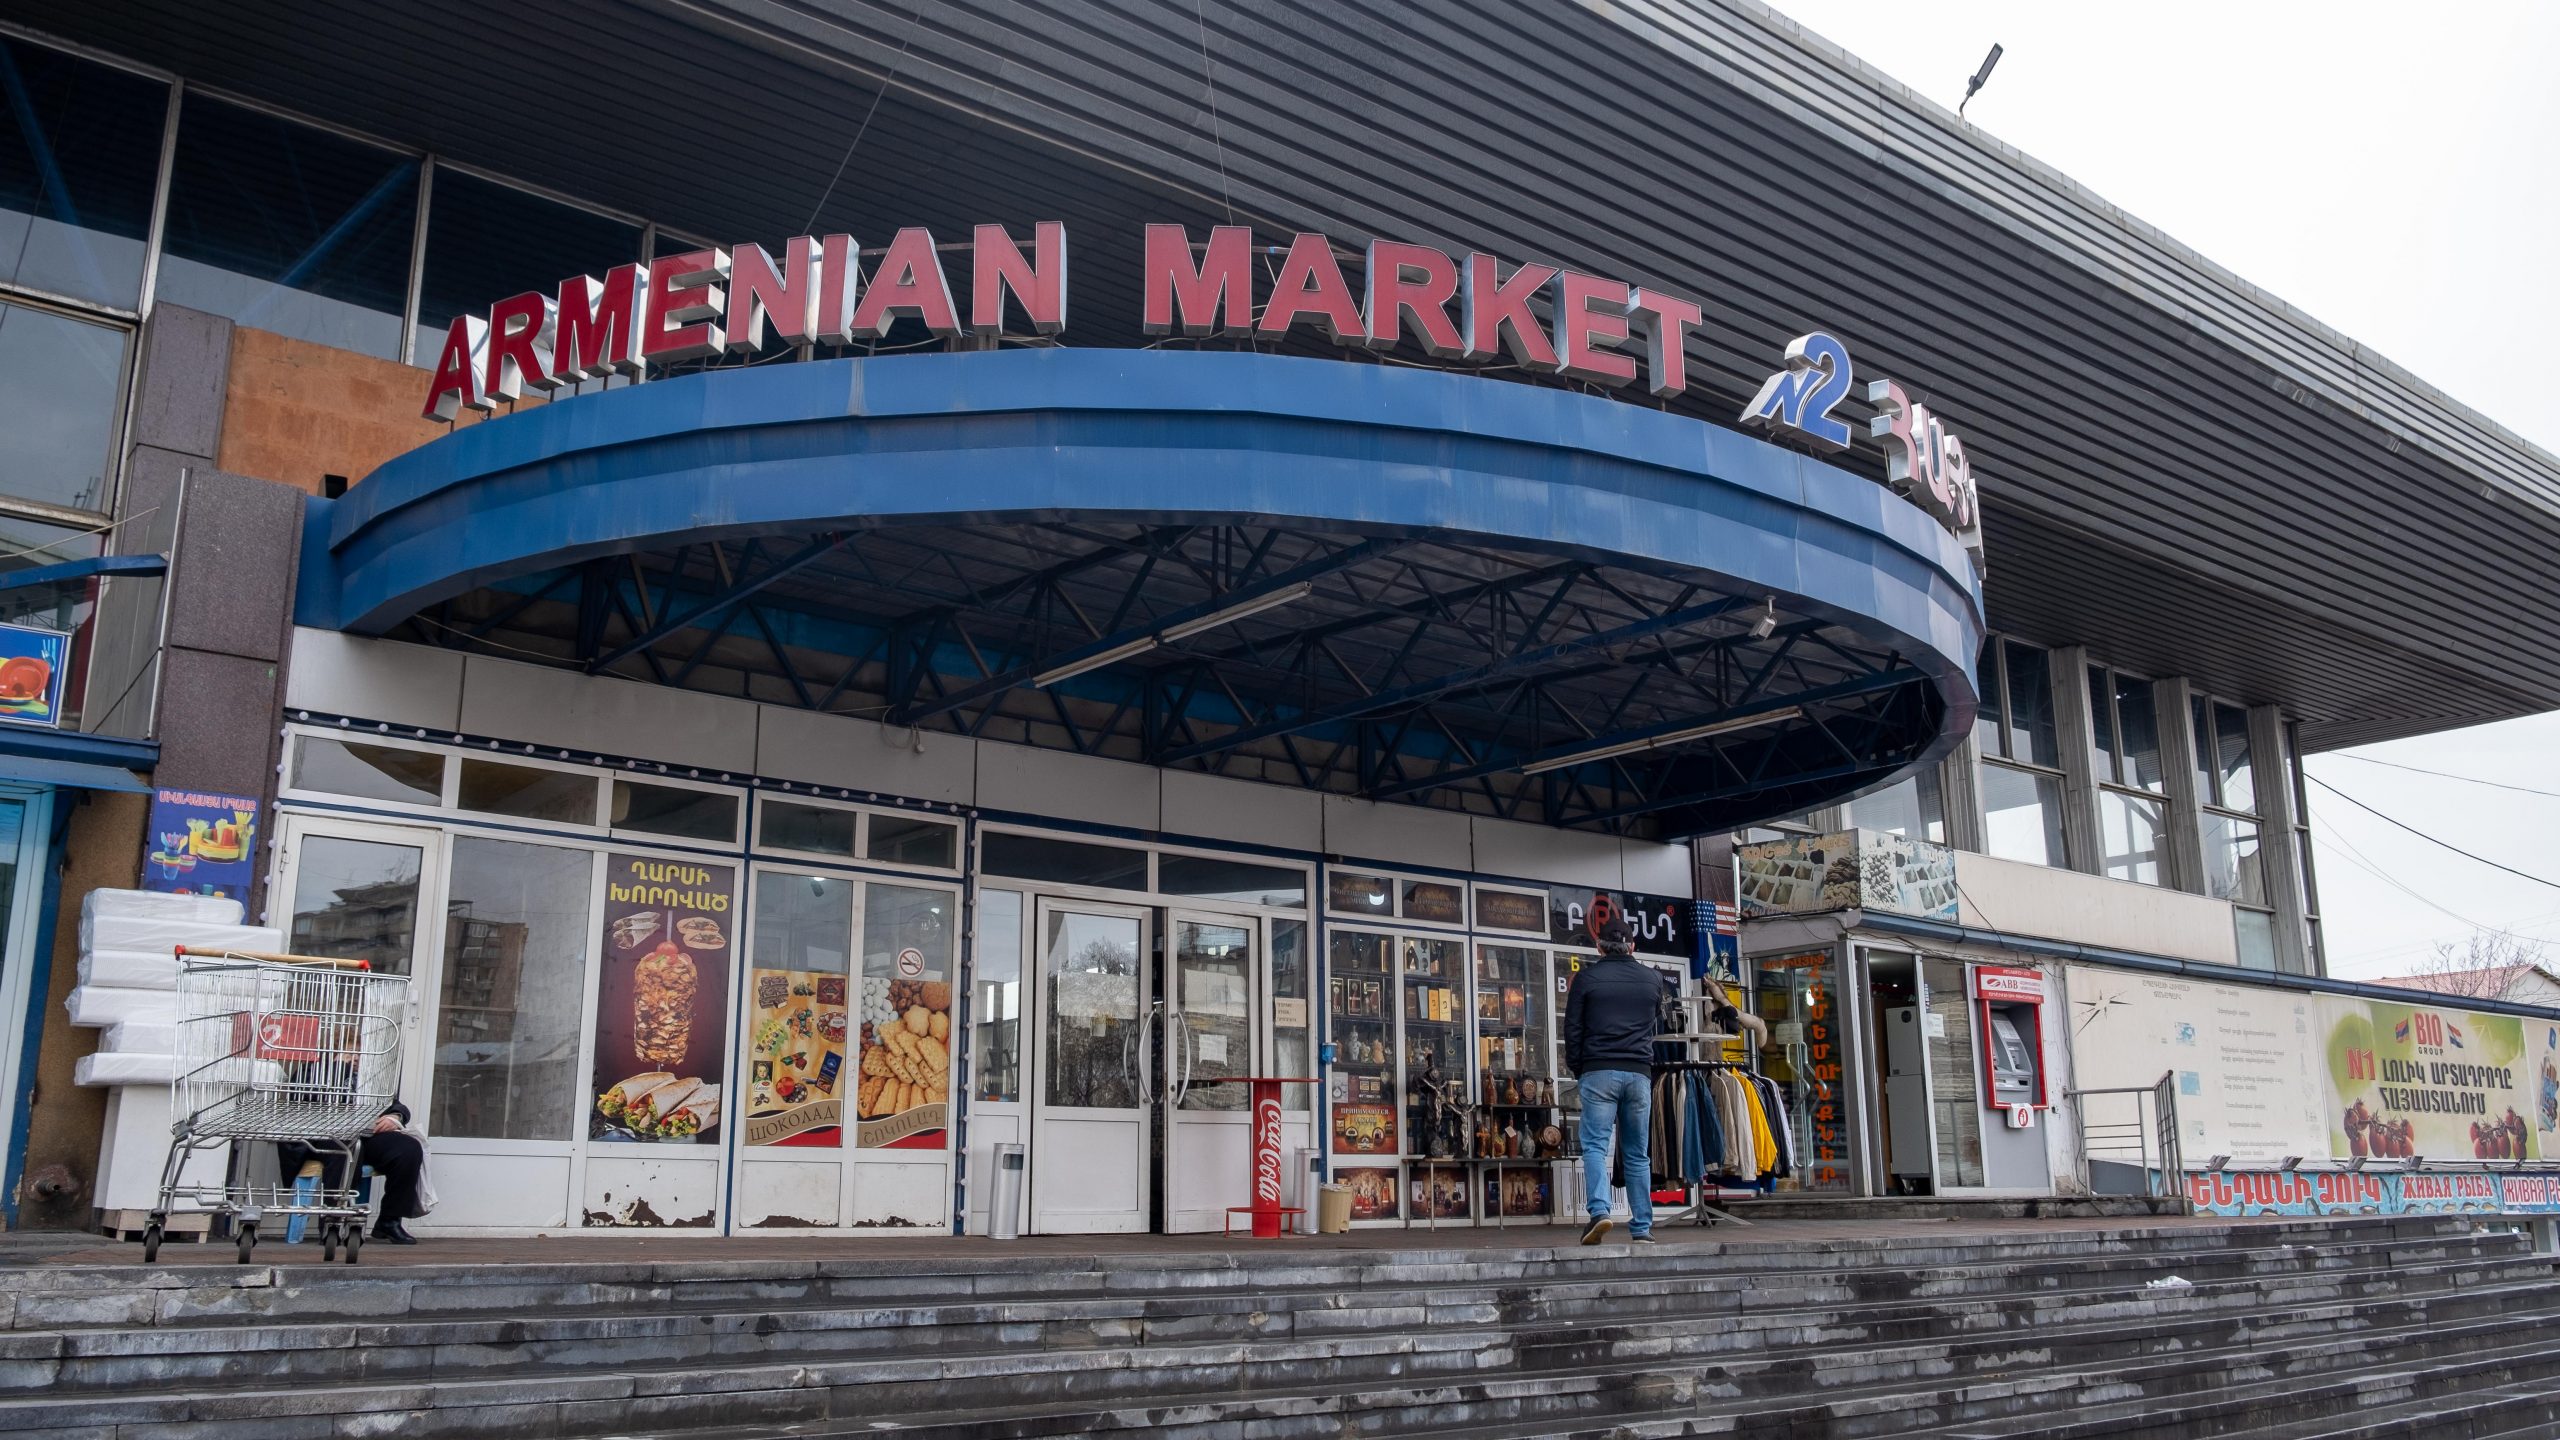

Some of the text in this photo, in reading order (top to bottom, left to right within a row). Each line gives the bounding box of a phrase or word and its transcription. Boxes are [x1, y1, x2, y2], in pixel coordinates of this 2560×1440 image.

[421, 220, 1066, 423] ARMENIAN
[1143, 223, 1702, 398] MARKET
[631, 861, 711, 886] ՂԱՐՍԻ
[610, 883, 729, 912] ԽՈՐՈՎԱԾ
[2001, 979, 2019, 990] ABB
[2414, 1012, 2443, 1047] BIO
[2418, 1046, 2444, 1056] GROUP
[2346, 1047, 2513, 1090] N1 ԼՈԼԻԿ ԱՐՏԱԴՐՈՂԸ
[2379, 1086, 2486, 1115] ՀԱՅԱՍՏԱՆՈՒՄ
[750, 1104, 835, 1141] ШОКОЛАД
[2185, 1172, 2383, 1207] ԵՆԴԱՆԻ ՁՈՒԿ
[2402, 1176, 2494, 1200] ЖИВАЯ РЫБА
[2503, 1178, 2547, 1204] ЖИВАЯ
